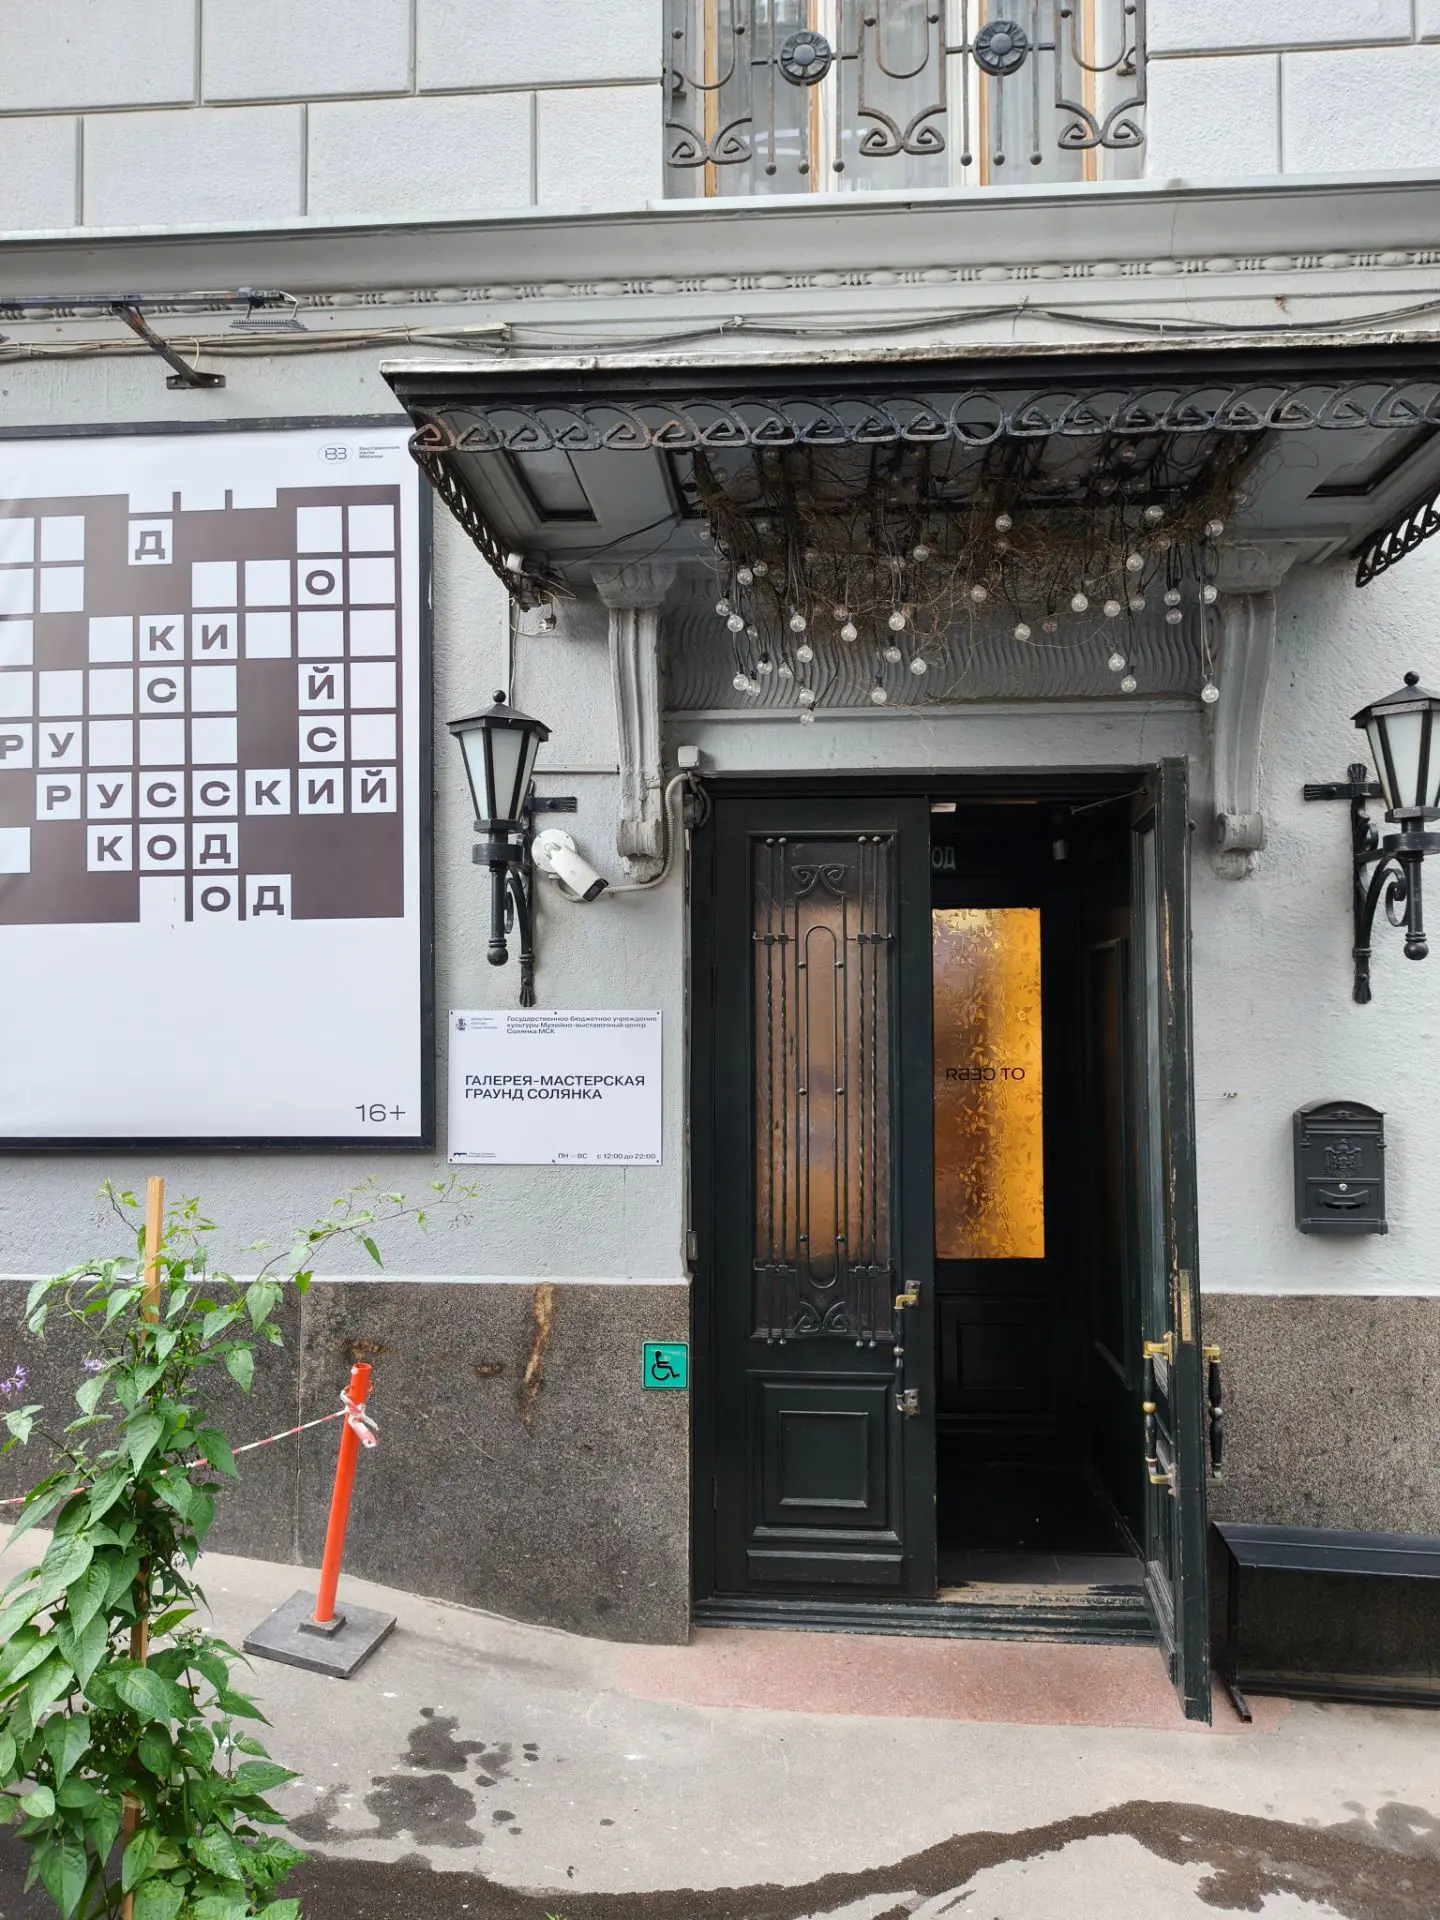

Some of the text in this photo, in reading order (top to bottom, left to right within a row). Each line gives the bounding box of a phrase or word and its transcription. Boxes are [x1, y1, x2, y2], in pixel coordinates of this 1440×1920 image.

[134, 530, 166, 561] Д
[308, 665, 335, 699] Й
[46, 769, 387, 811] РУССКИЙ
[97, 833, 232, 864] КОД
[200, 886, 285, 917] ОД
[465, 1075, 645, 1087] ГАЛЕРЕЯ-МАСТЕРСКАЯ
[465, 1088, 602, 1101] ГРАУНД СОЛЯНКА
[355, 1103, 406, 1122] 16+
